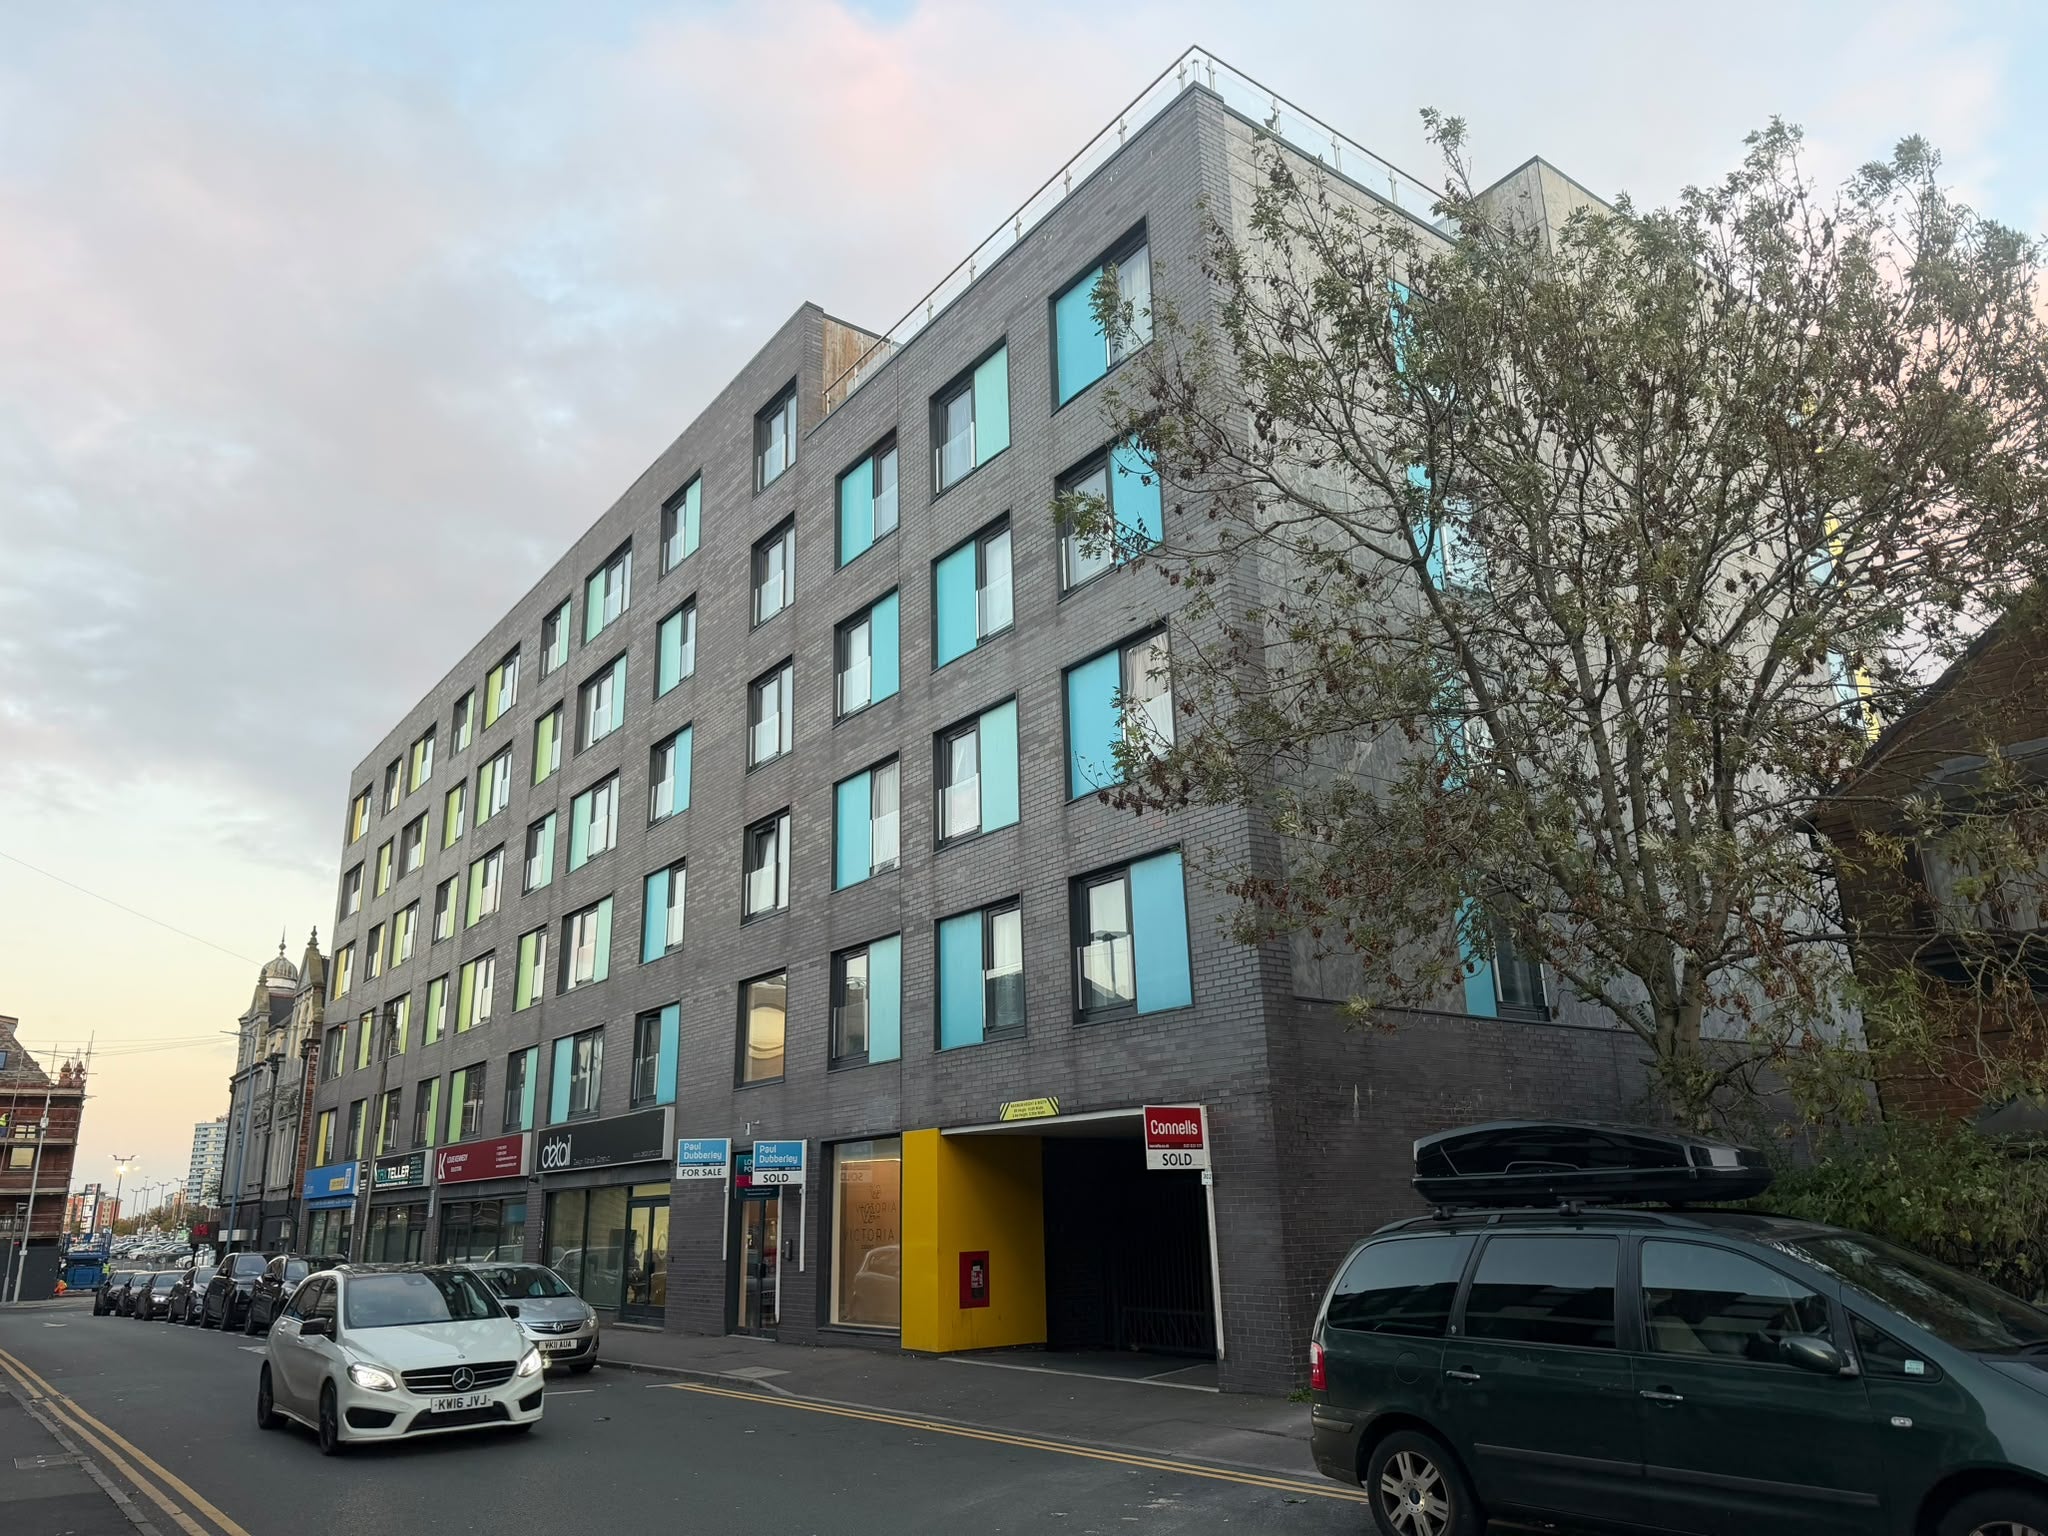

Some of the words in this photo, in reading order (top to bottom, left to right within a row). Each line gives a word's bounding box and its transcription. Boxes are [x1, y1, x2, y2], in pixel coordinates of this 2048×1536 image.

[1150, 1119, 1198, 1135] Connells
[541, 1133, 572, 1169] detail
[683, 1142, 702, 1152] Paul
[759, 1144, 777, 1153] Paul
[683, 1151, 722, 1160] Dubberley
[759, 1154, 798, 1164] Dubberley
[1162, 1153, 1192, 1166] SOLD
[682, 1169, 699, 1177] FOR
[701, 1168, 722, 1176] SALE
[763, 1173, 789, 1183] SOLD
[842, 1228, 895, 1242] VICTORIA
[559, 1340, 572, 1349] AUA
[438, 1397, 464, 1410] KW16
[466, 1394, 487, 1407] JVJ
